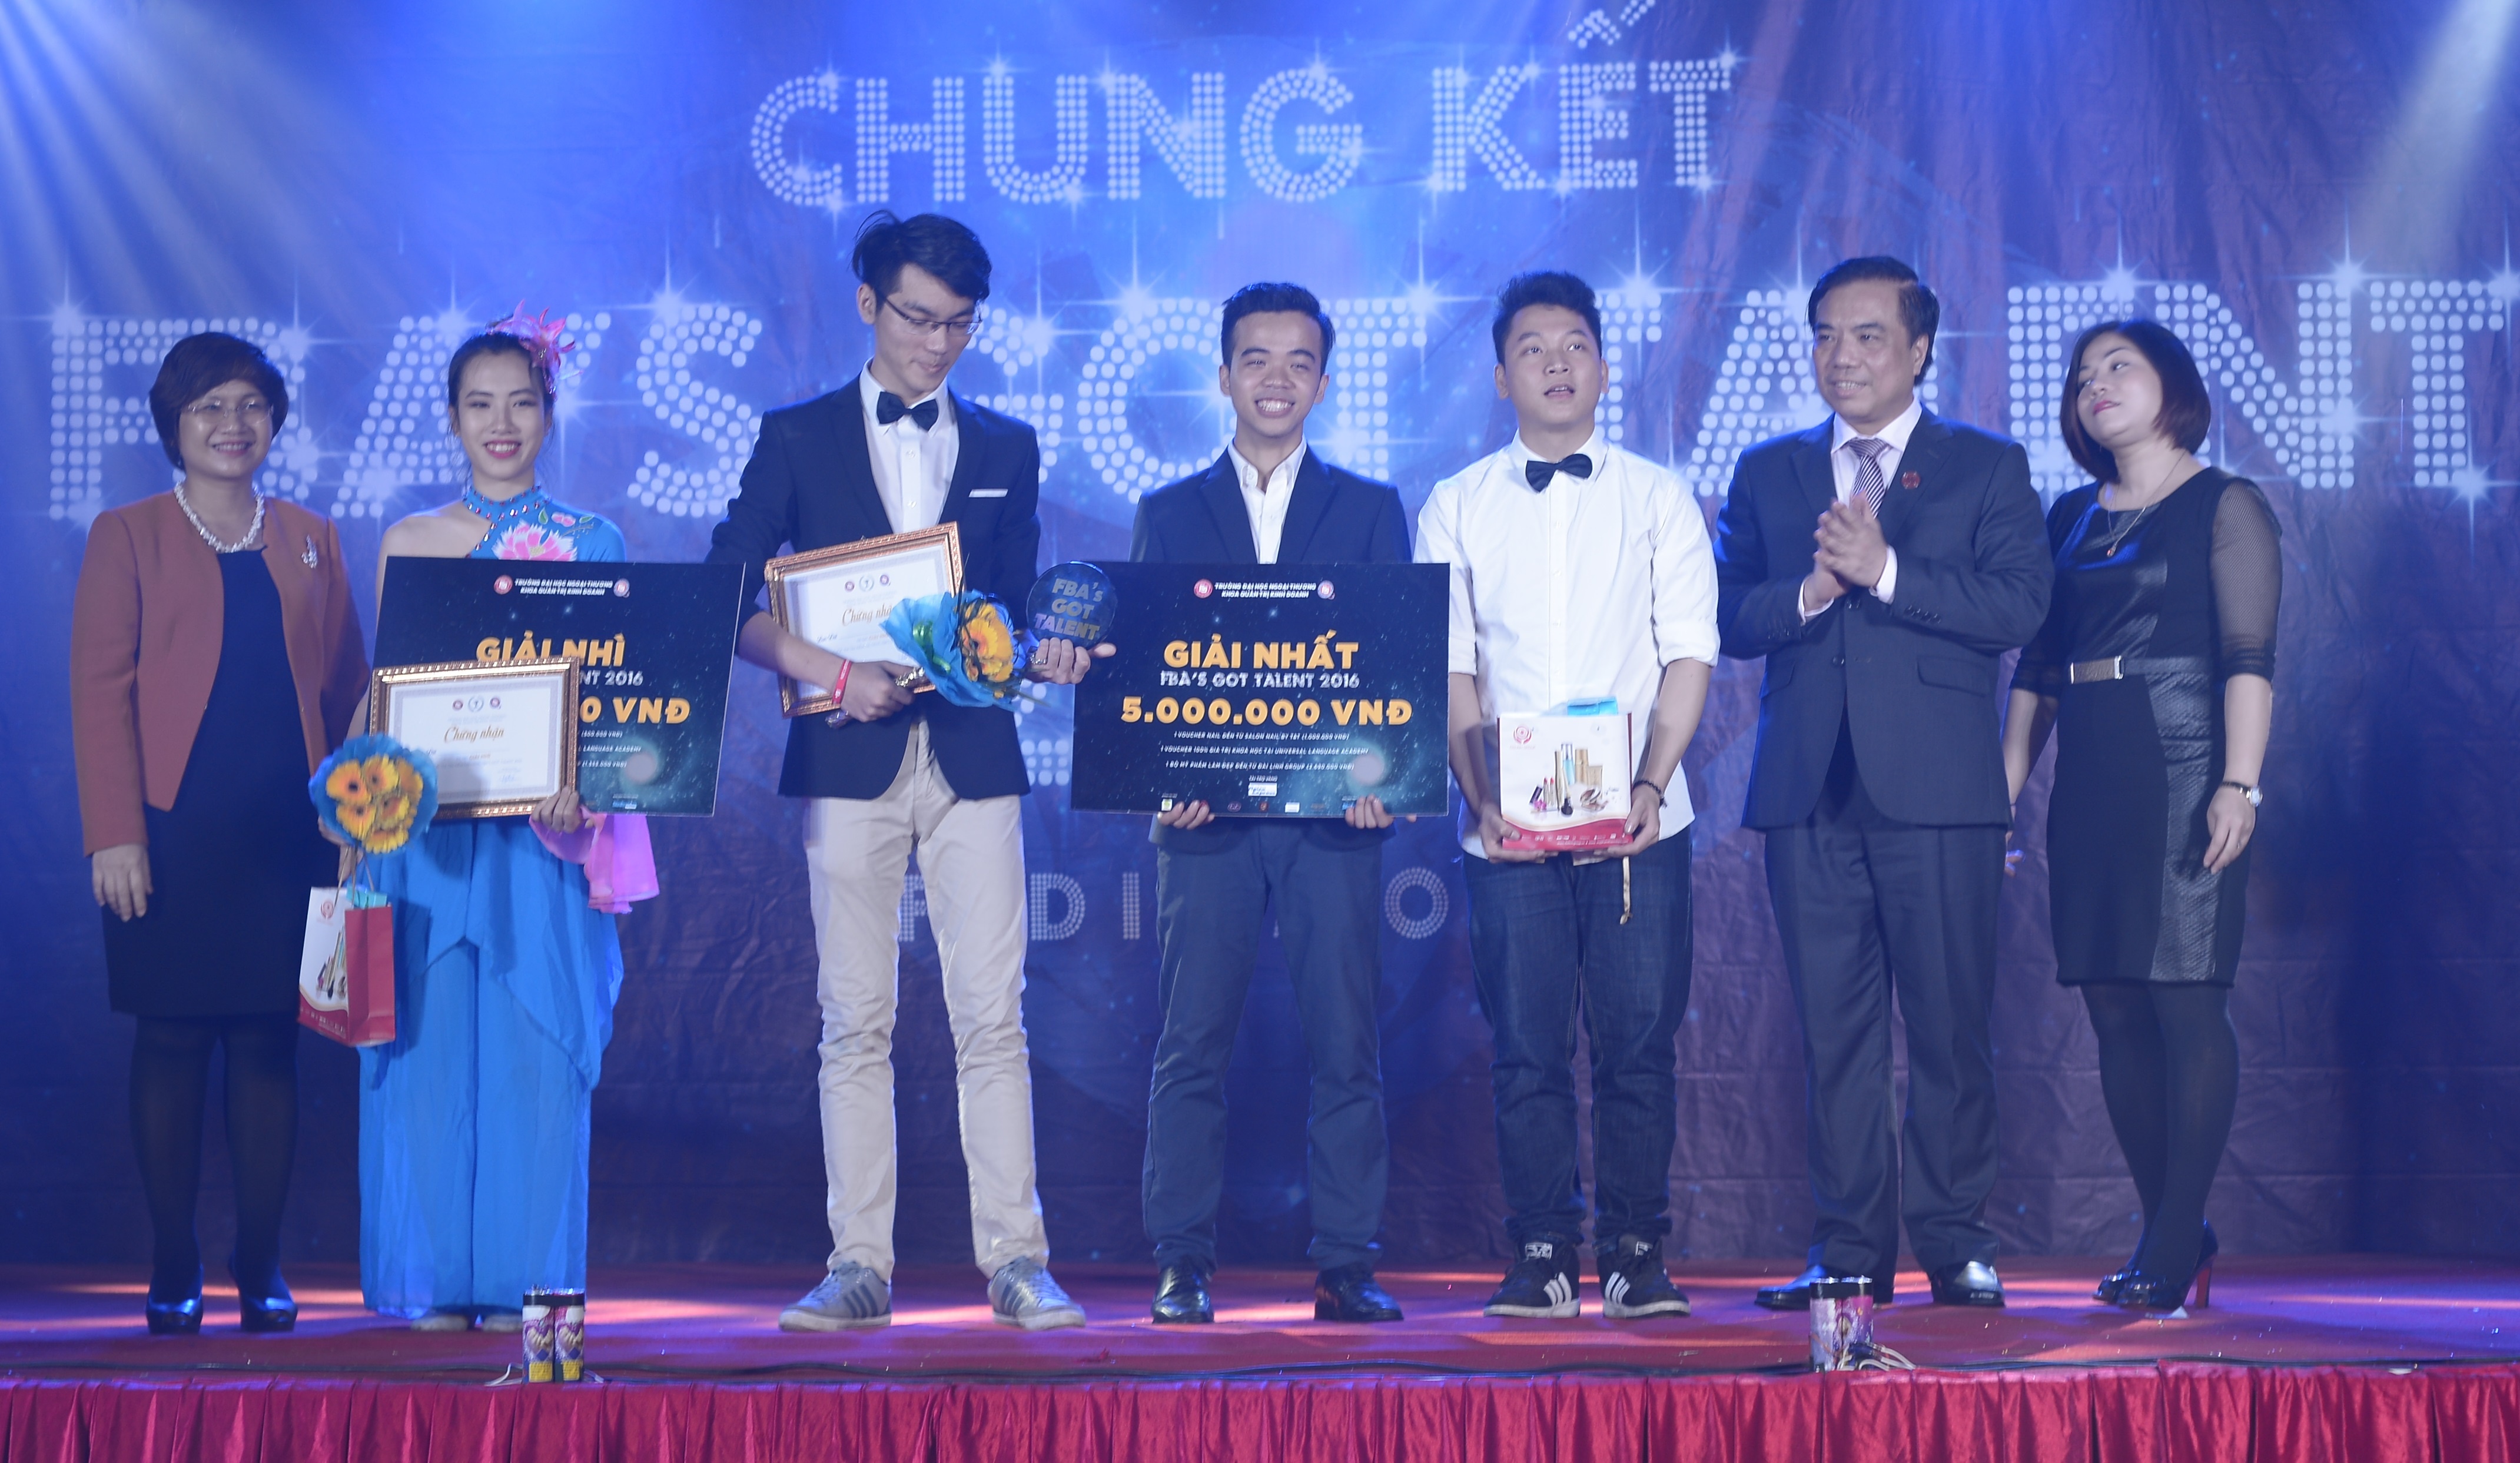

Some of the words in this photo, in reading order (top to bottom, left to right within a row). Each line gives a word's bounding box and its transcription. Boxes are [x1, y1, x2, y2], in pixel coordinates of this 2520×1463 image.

[750, 67, 1363, 204] CHUNG
[1432, 0, 1733, 192] KẾT
[1594, 279, 2508, 499] TAENT
[1051, 598, 1094, 619] GOT
[1034, 613, 1100, 640] TALENT
[476, 630, 552, 661] GIẢI
[562, 632, 626, 667] NHÌ
[1163, 633, 1241, 669] GIẢI
[1253, 629, 1359, 670] NHẤT
[605, 671, 644, 686] 2016
[1160, 670, 1207, 687] FBA'S
[1213, 672, 1249, 688] GOT
[1254, 672, 1315, 688] TALENT
[1319, 672, 1360, 689] 2016
[612, 696, 691, 724] VNĐ
[1121, 696, 1320, 725] 5.000.000
[1331, 699, 1413, 726] VNĐ
[1178, 731, 1206, 739] VOUCHER
[1207, 731, 1221, 739] NAIL
[1244, 731, 1264, 740] SALON
[1164, 745, 1193, 753] VOUCHER
[1194, 745, 1208, 754] 100%
[1274, 747, 1306, 755] UNIVERSAL
